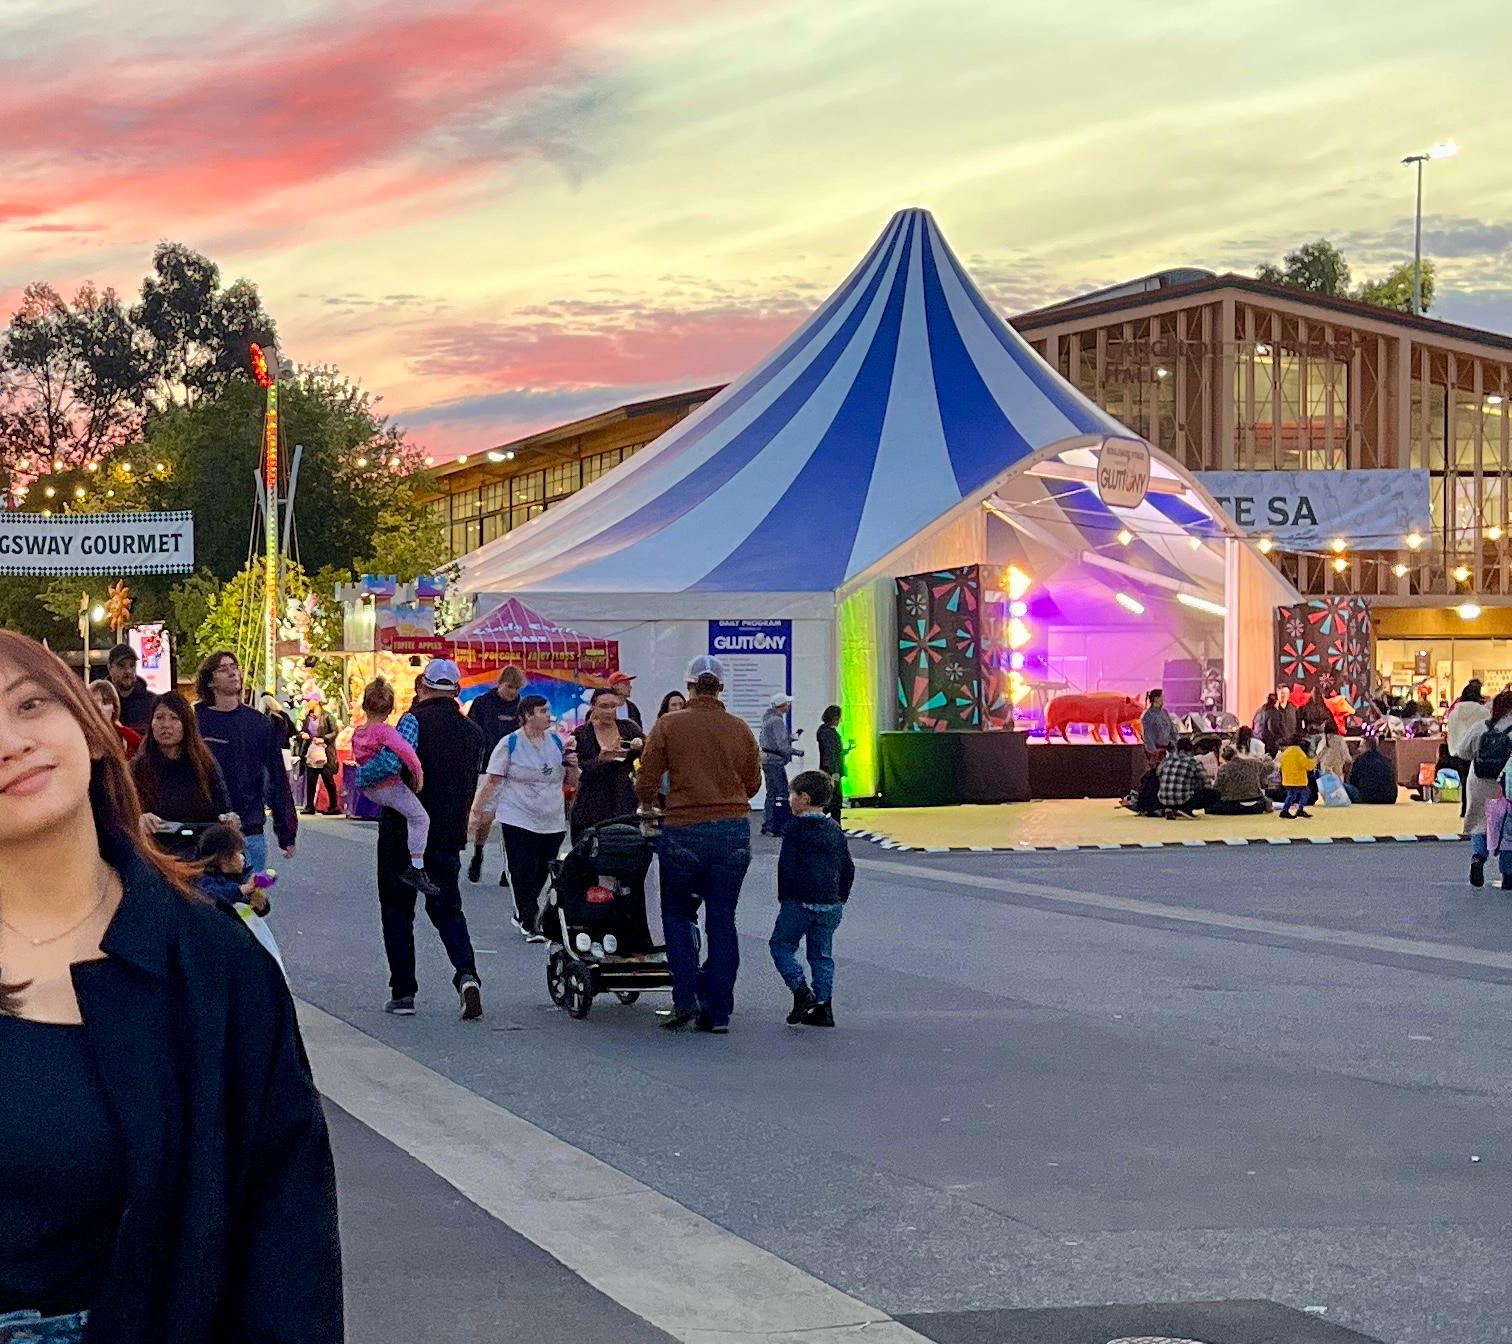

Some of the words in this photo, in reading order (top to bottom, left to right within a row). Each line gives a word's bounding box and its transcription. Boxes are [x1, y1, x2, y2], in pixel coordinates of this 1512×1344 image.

[1268, 496, 1318, 526] SA
[80, 533, 183, 554] GOURMET
[713, 633, 786, 650] GLUTTONY
